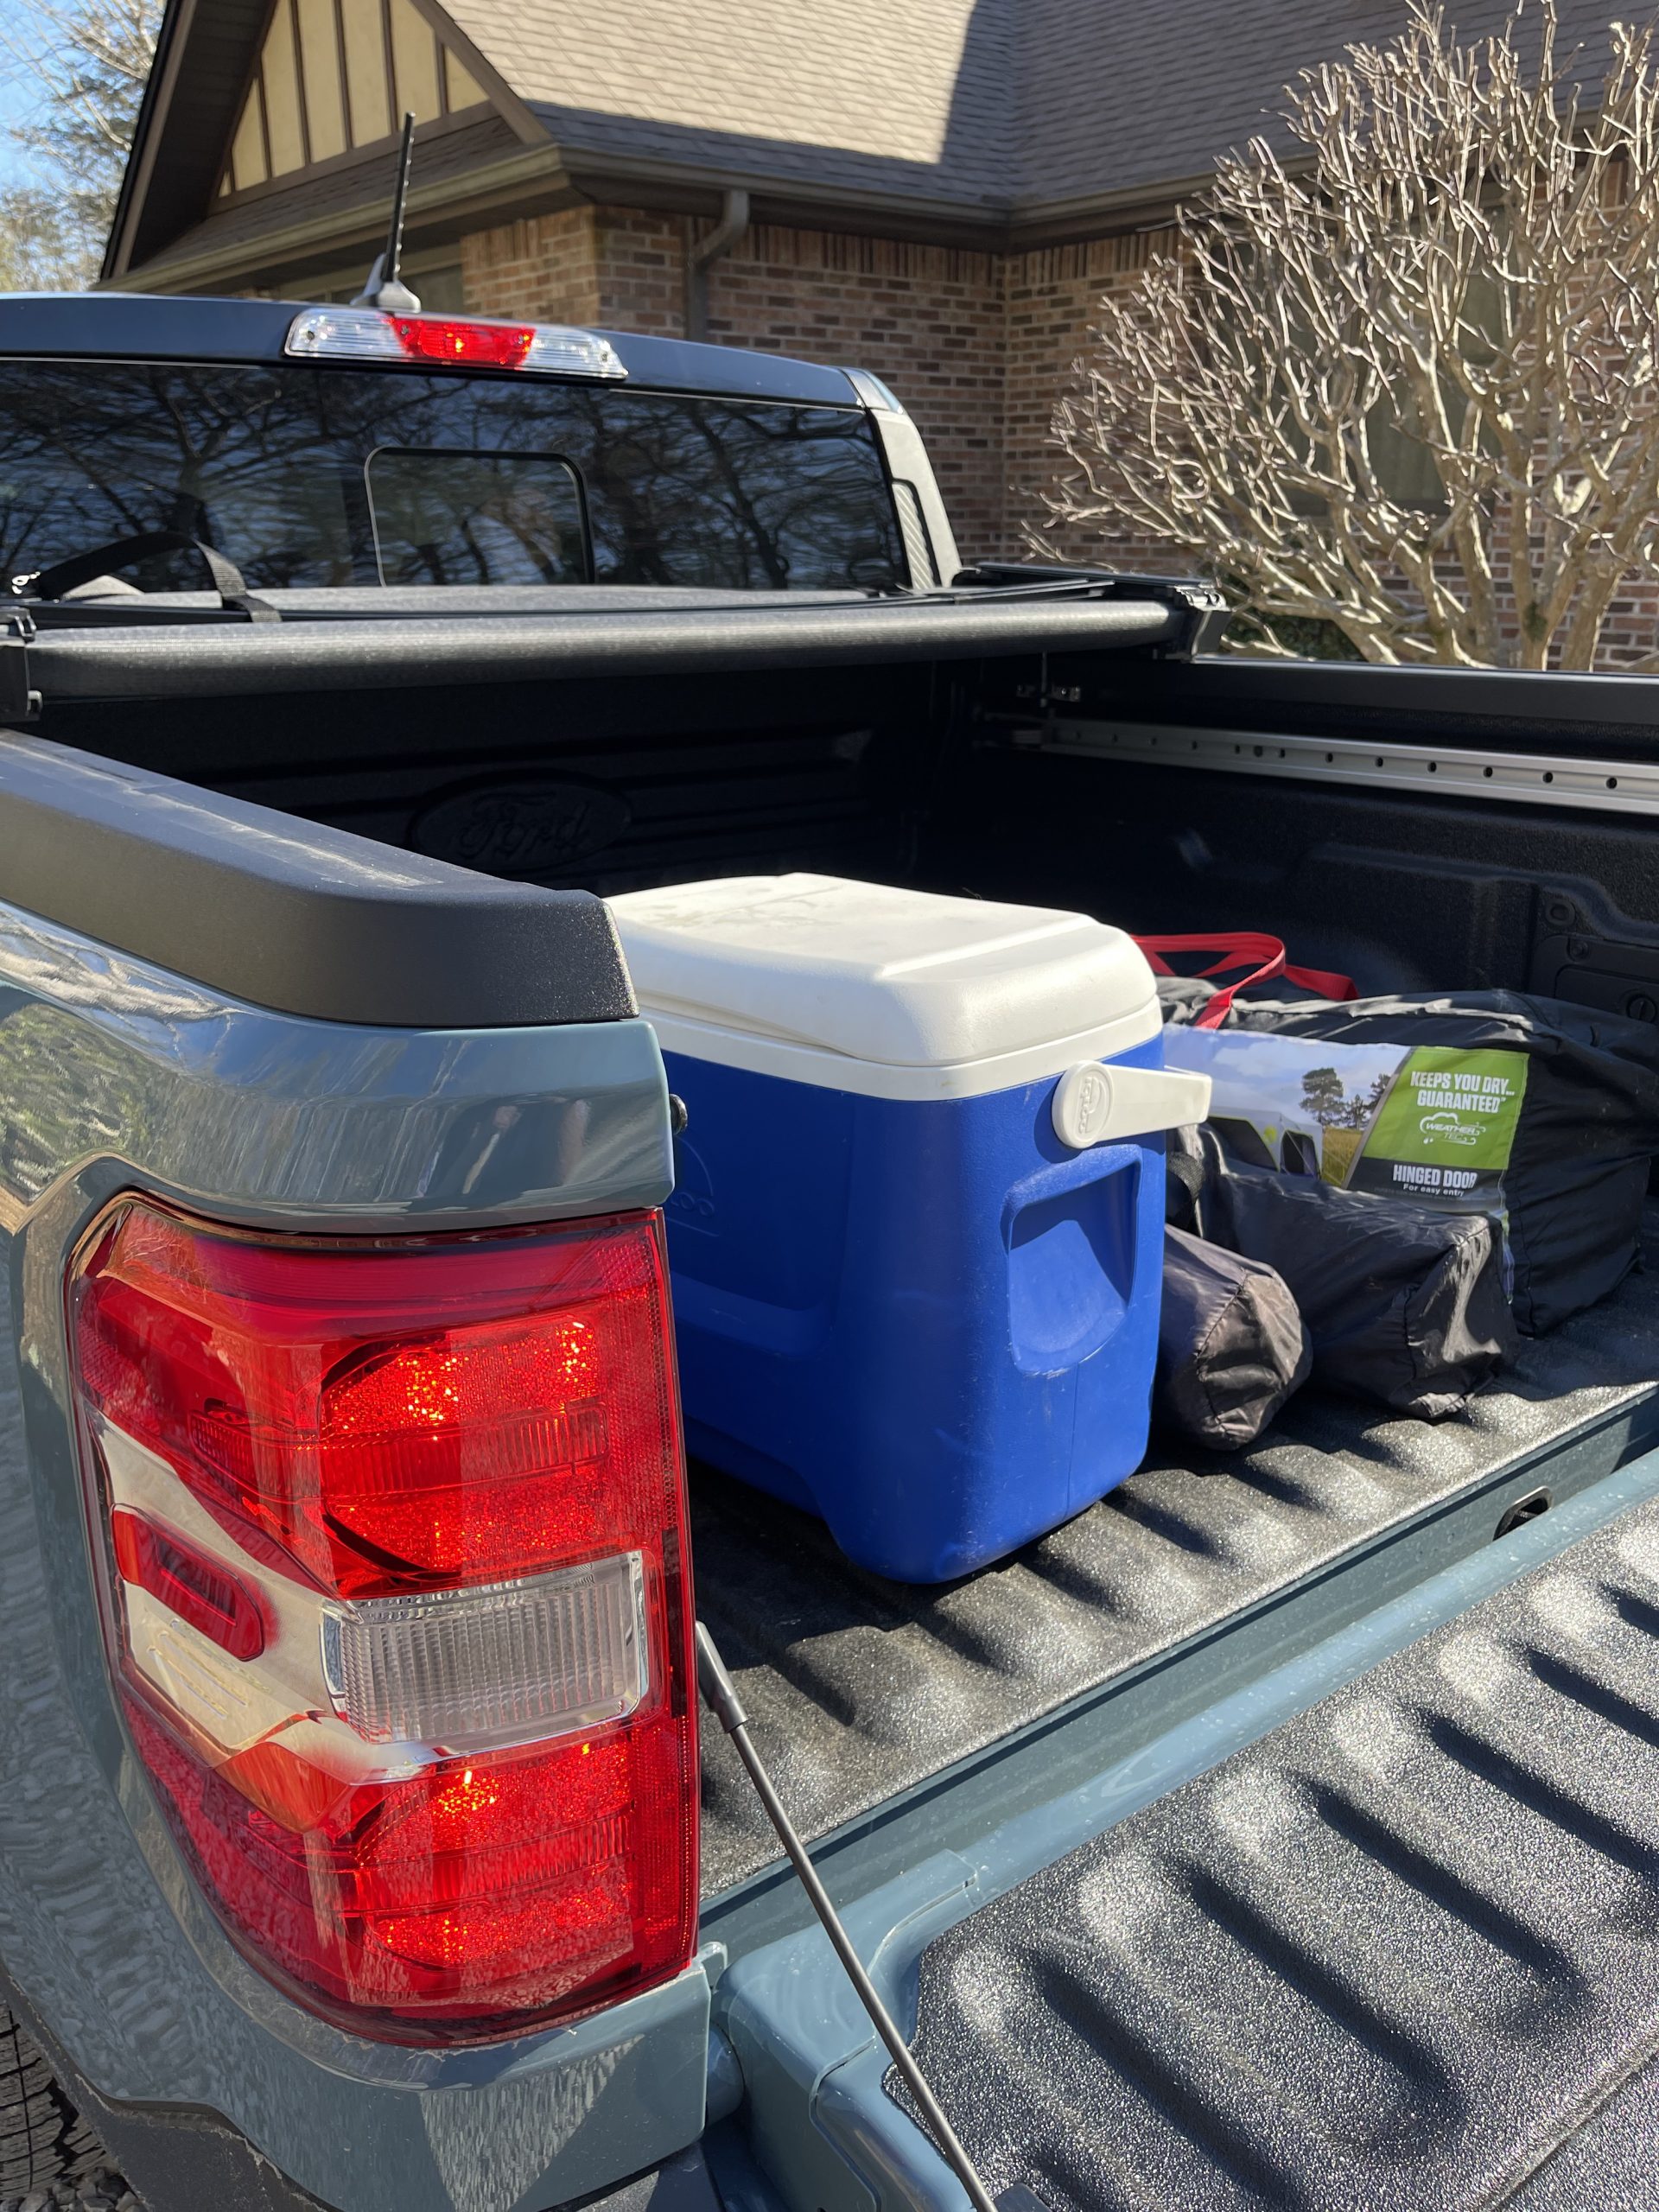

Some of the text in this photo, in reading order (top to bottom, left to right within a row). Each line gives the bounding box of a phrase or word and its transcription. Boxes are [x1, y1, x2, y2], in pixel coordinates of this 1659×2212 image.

[455, 791, 592, 860] Ford
[1410, 1071, 1515, 1096] KEEPS YOU DRY...
[1426, 1122, 1476, 1135] WEATHER
[1393, 1165, 1478, 1189] HINGED DOOR
[1403, 1183, 1418, 1192] For
[1421, 1186, 1440, 1195] easy
[1443, 1189, 1464, 1198] entry
